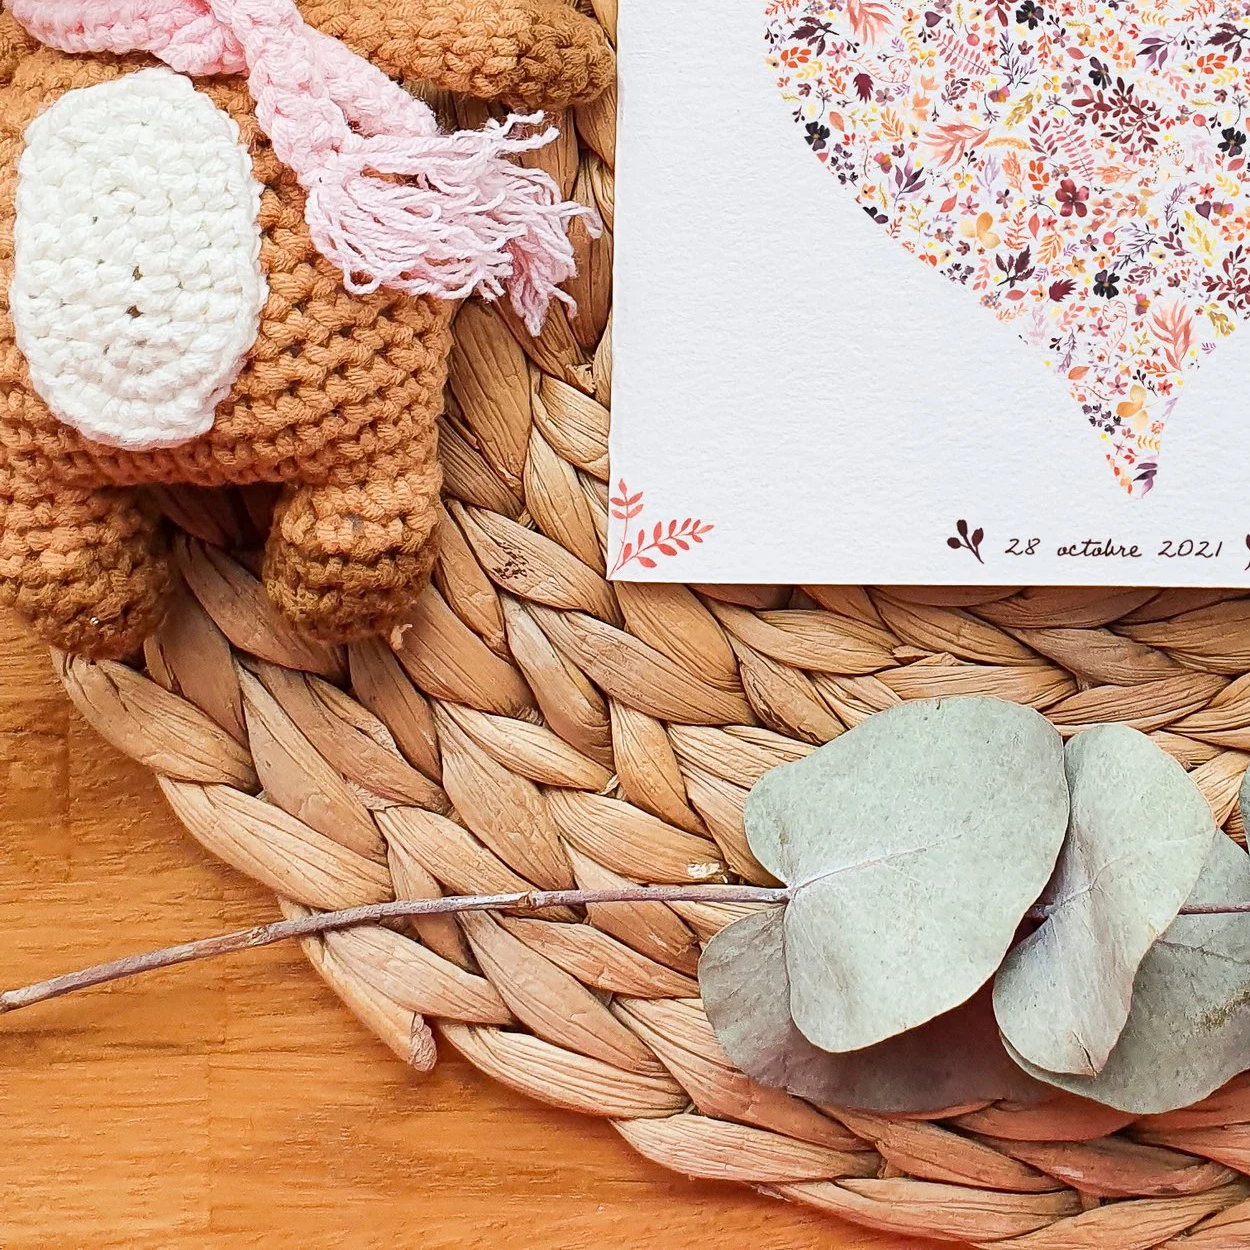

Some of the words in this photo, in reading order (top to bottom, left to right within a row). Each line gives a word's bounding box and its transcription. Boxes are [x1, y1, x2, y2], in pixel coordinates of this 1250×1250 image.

[1005, 538, 1041, 556] 28
[1056, 539, 1143, 558] octobre
[1157, 540, 1223, 558] 2021
